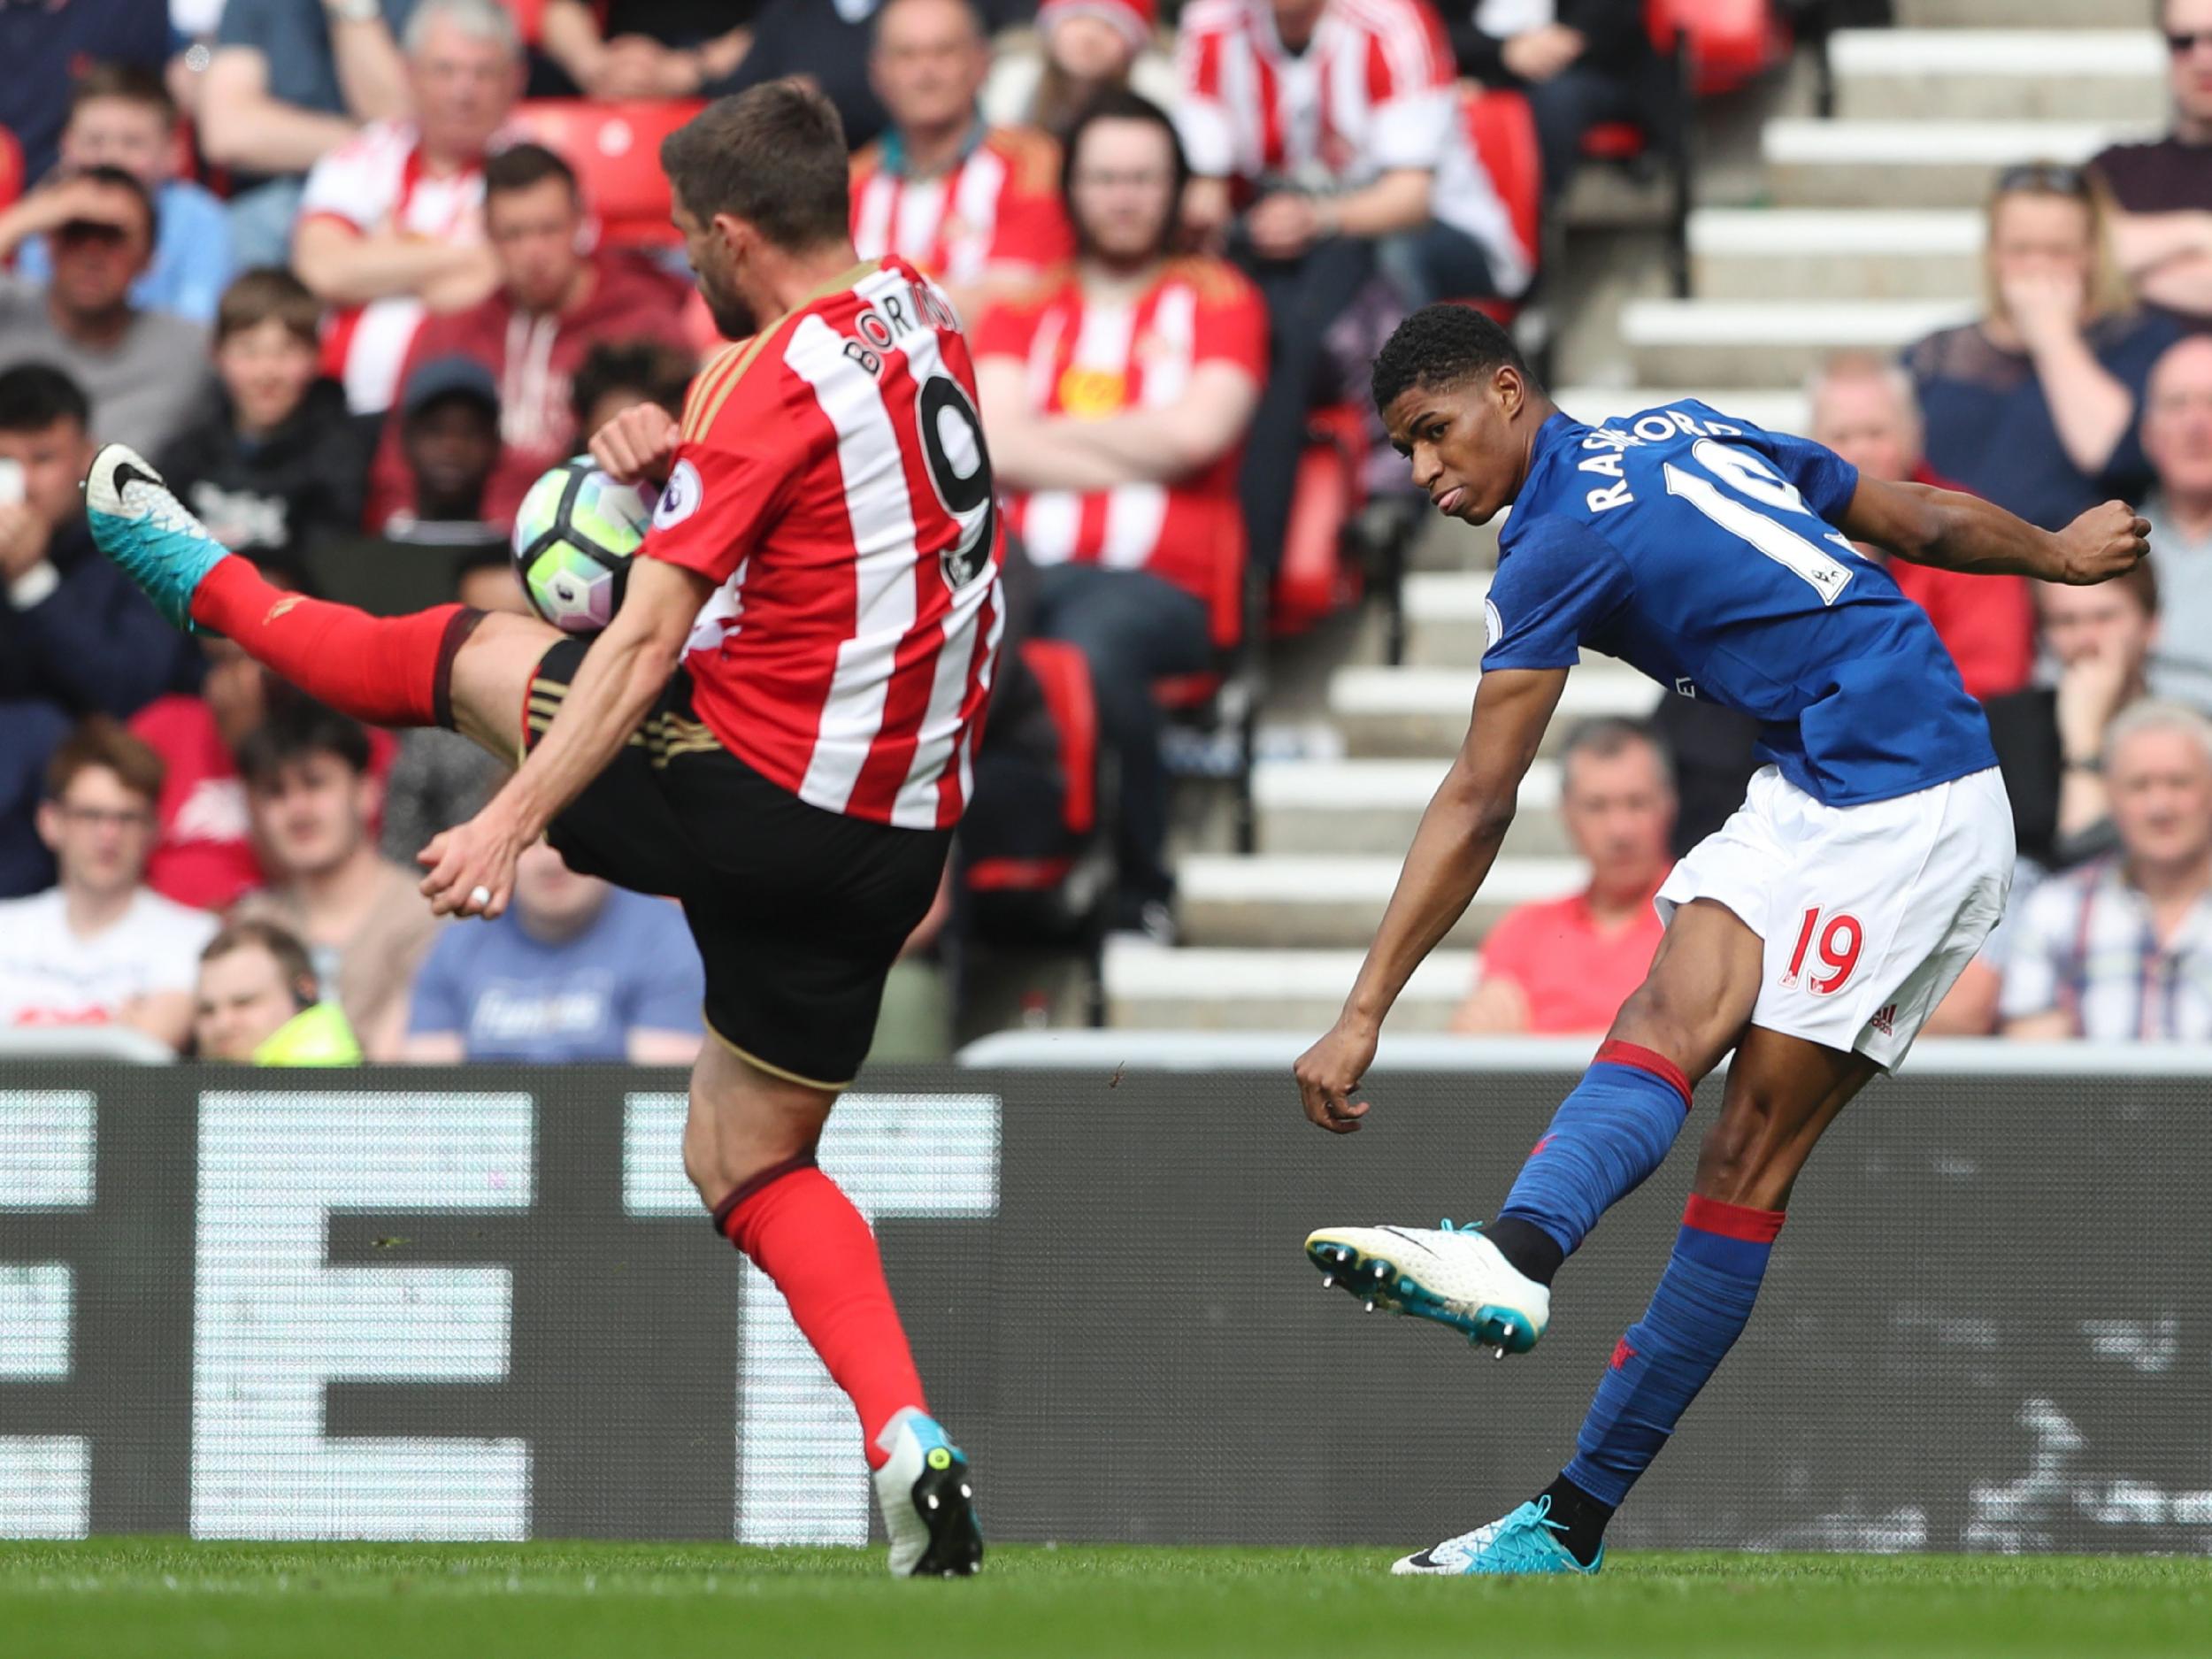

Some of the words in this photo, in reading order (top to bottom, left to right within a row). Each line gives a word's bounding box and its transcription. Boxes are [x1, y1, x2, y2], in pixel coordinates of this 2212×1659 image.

[917, 373, 994, 589] 9
[1663, 438, 1868, 606] 19
[1778, 904, 1865, 997] 19
